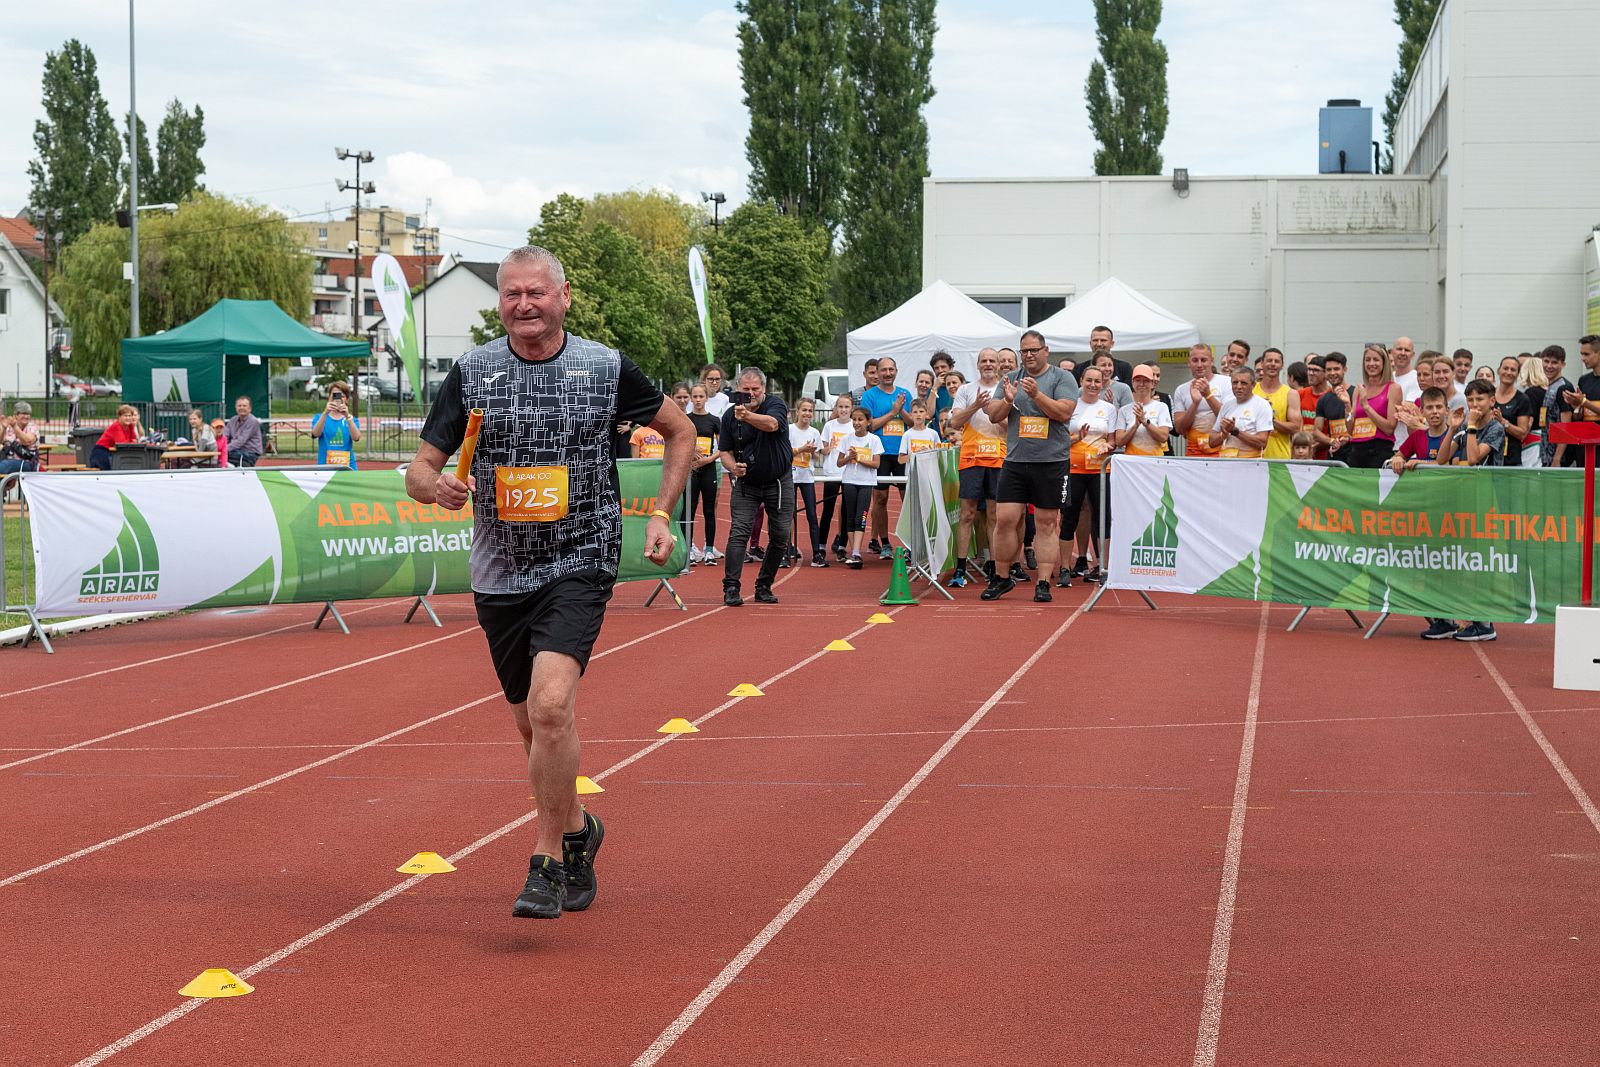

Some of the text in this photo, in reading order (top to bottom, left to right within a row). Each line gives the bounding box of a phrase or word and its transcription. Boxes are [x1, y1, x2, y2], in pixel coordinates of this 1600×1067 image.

[1023, 424, 1045, 433] 1927
[978, 444, 997, 453] 1929
[537, 472, 552, 480] 100
[505, 487, 559, 508] 1925
[318, 502, 392, 528] ALBA
[1297, 505, 1355, 535] ALBA
[1361, 510, 1433, 538] REGIA
[1439, 507, 1567, 543] ATLÉTIKAI
[1132, 551, 1174, 566] ARAK
[1295, 541, 1518, 573] www.arakatletika.hu
[83, 577, 156, 593] ARAK
